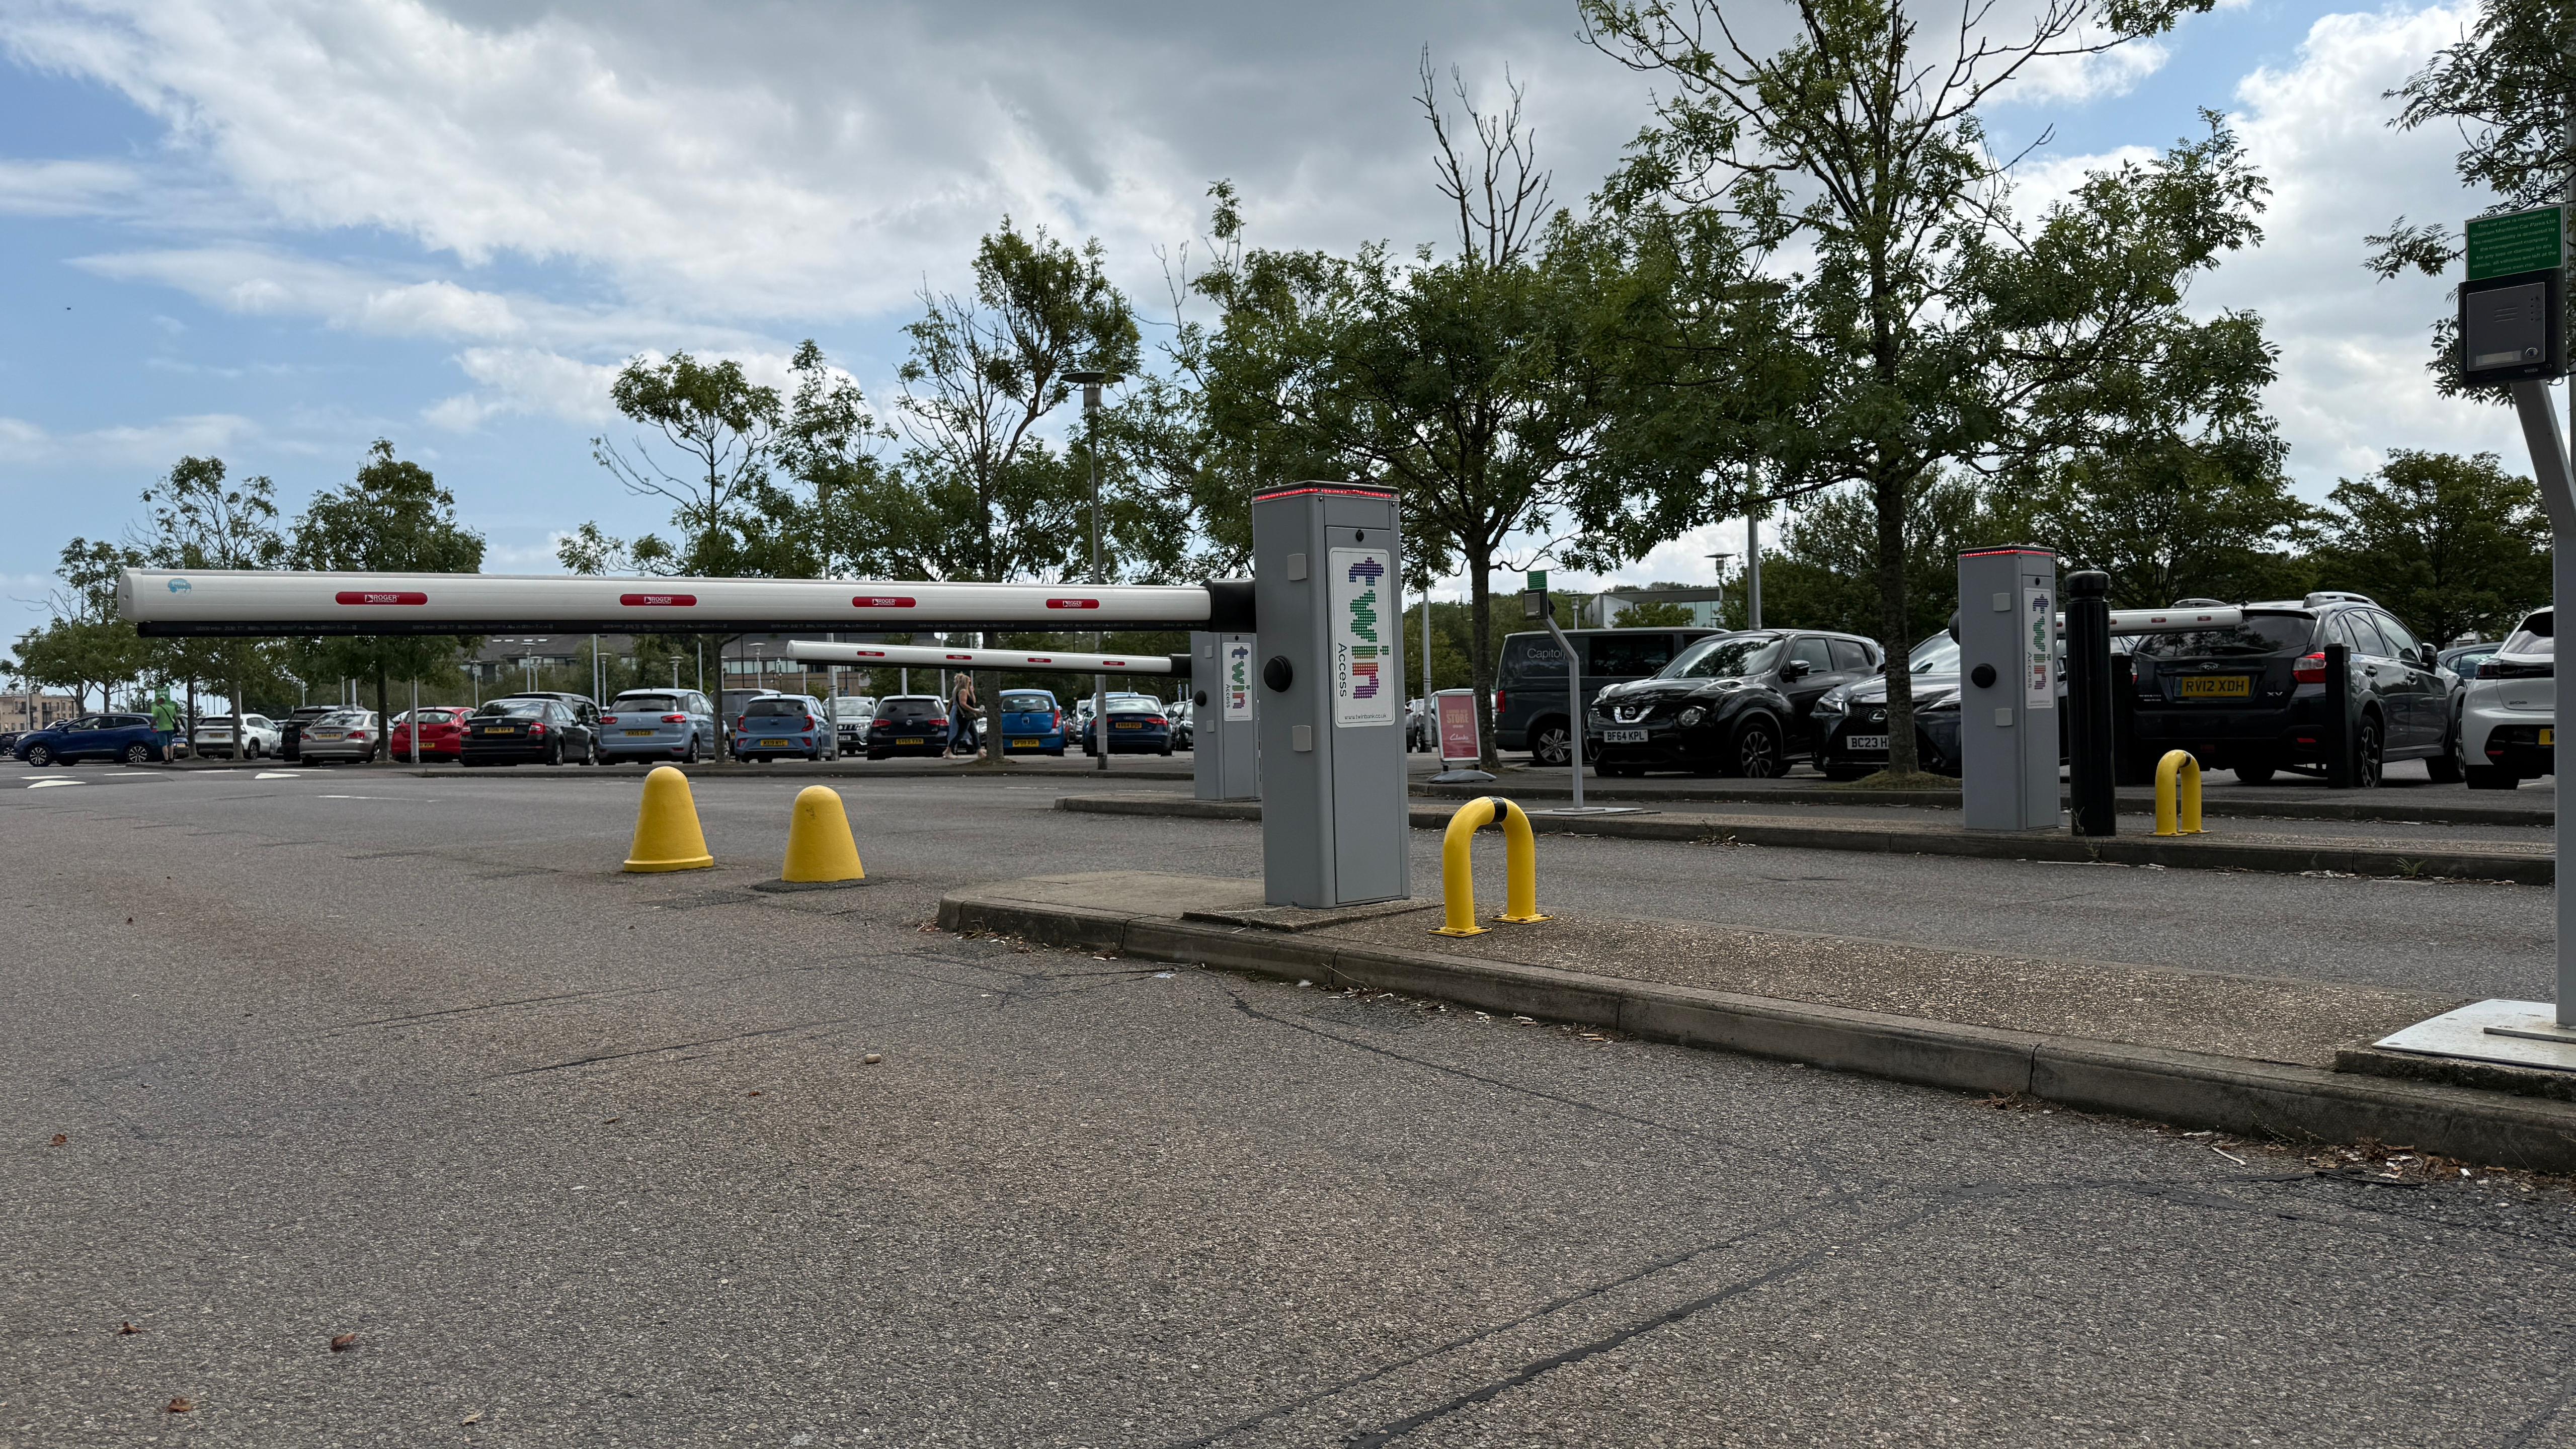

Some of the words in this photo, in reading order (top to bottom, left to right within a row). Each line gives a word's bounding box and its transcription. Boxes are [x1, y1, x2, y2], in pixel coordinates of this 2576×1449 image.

[1349, 557, 1389, 699] twin
[2033, 594, 2051, 689] twin
[1232, 646, 1250, 708] twin
[1338, 643, 1347, 697] Access
[2186, 681, 2214, 692] RV12
[2218, 680, 2244, 692] XDH
[1446, 714, 1469, 723] STORE
[1607, 732, 1627, 741] BF64
[1629, 731, 1644, 740] KPL
[1852, 738, 1878, 747] BC23
